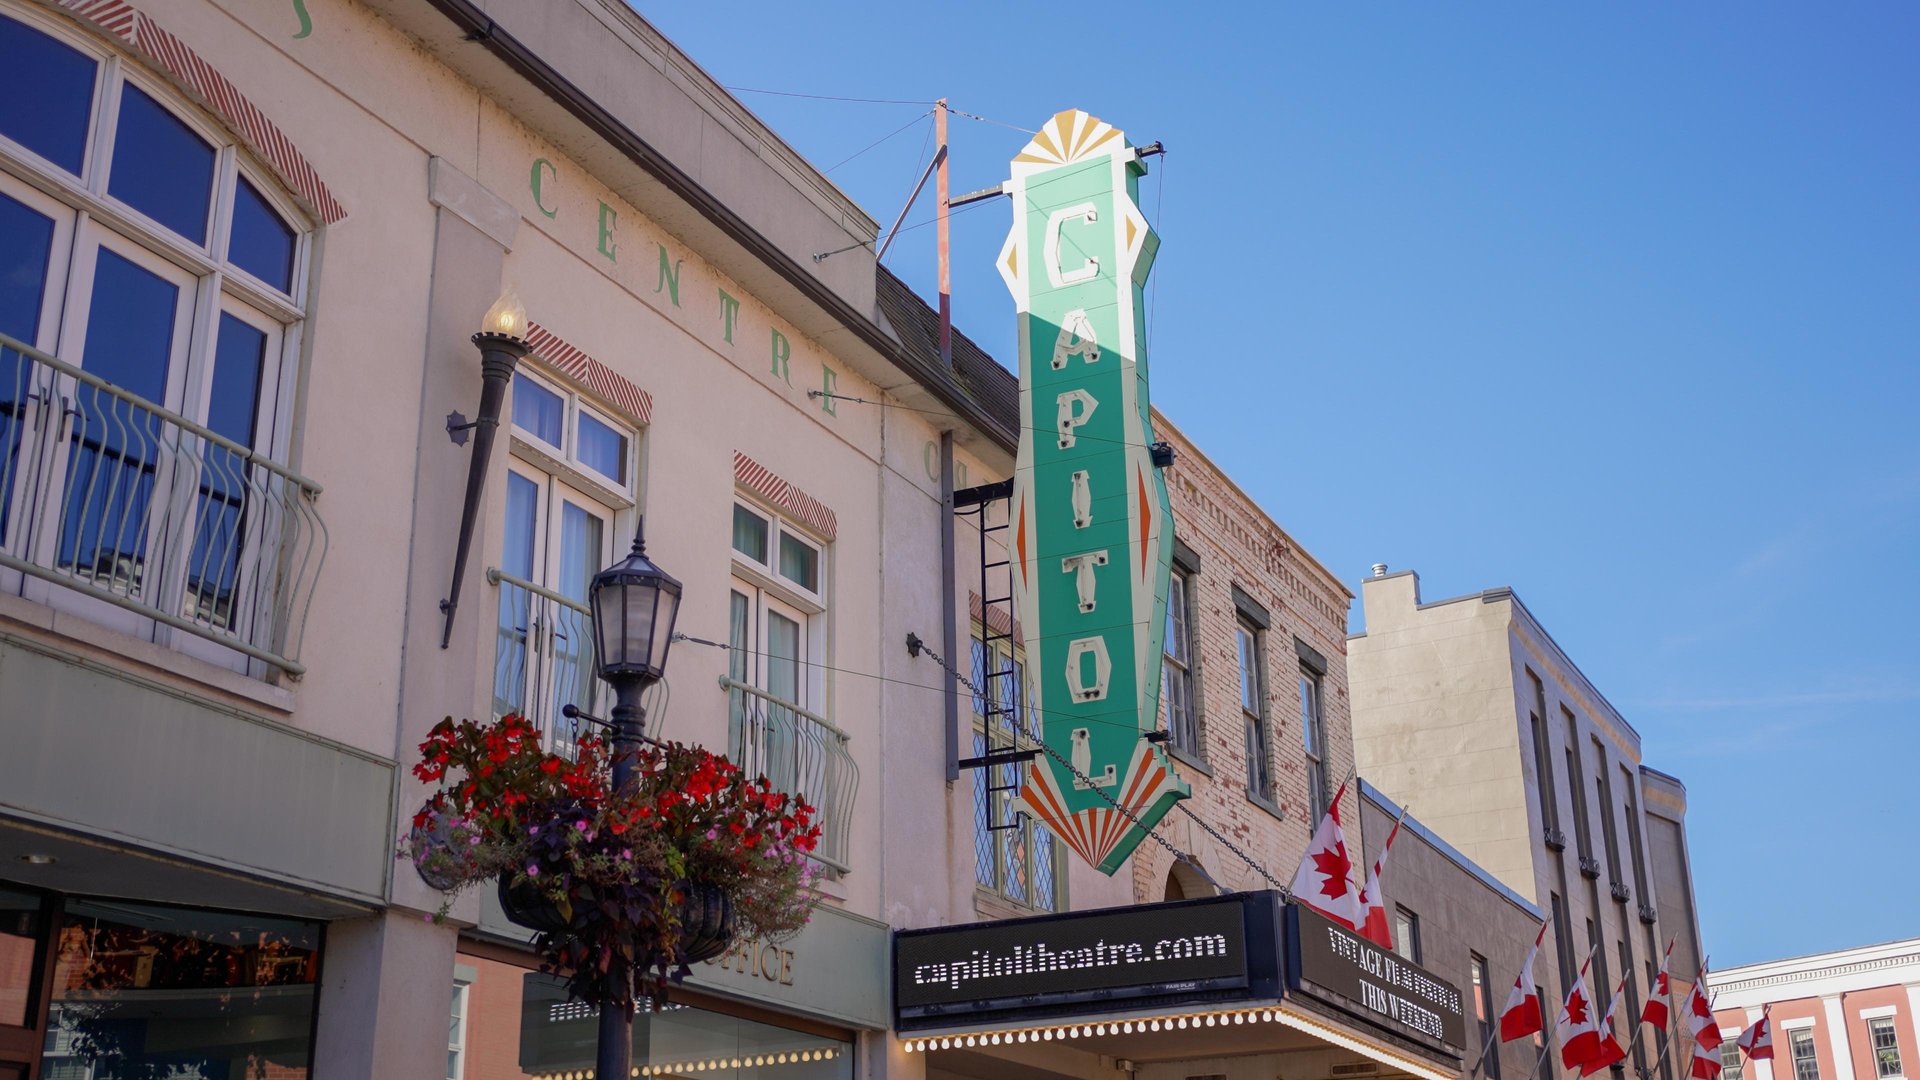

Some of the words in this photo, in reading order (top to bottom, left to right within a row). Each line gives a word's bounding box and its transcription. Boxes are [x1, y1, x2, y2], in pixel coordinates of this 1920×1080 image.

[530, 157, 838, 418] CENTRE
[1042, 202, 1117, 791] CAPITOL
[914, 933, 1227, 989] capitoltheatre.com
[1327, 926, 1383, 979] VINTAGE
[1359, 978, 1388, 1015] THIS
[1388, 992, 1443, 1039] WEEKEND
